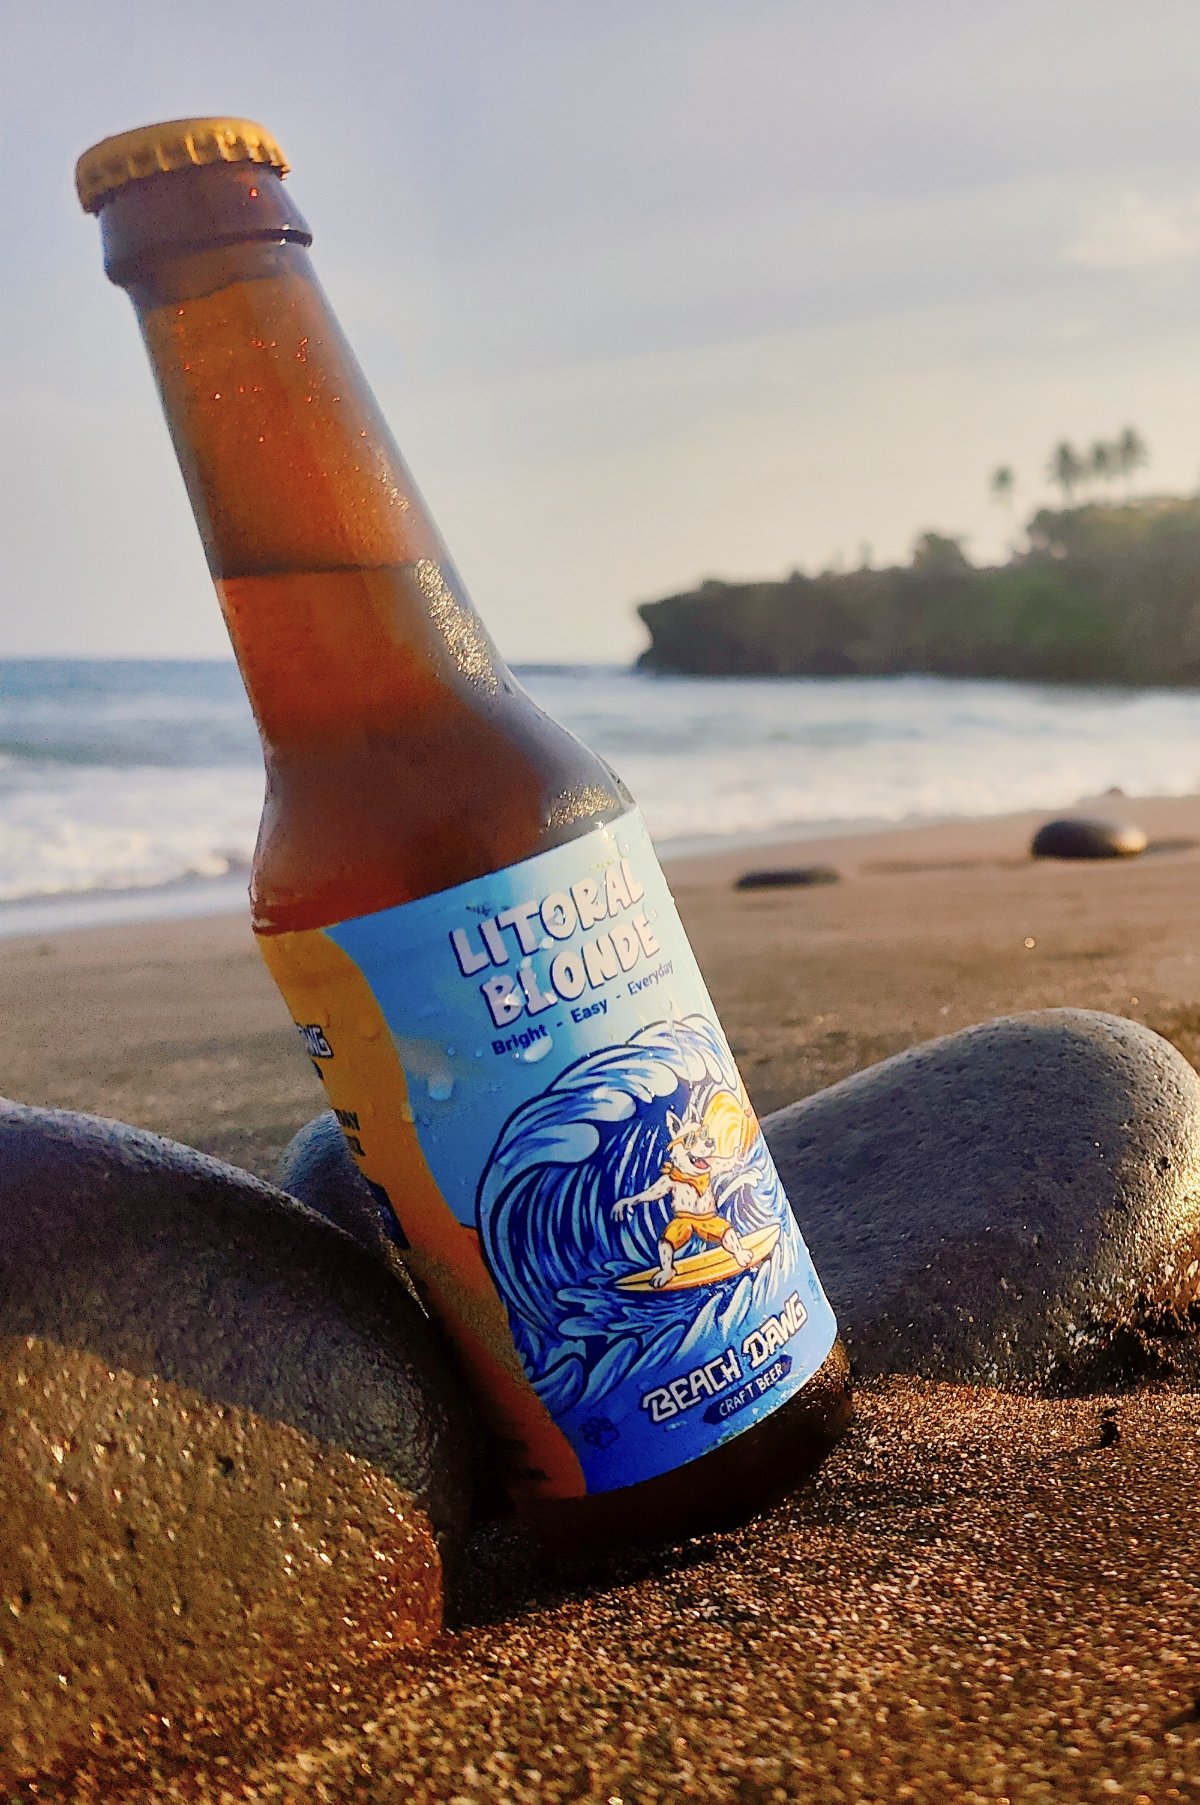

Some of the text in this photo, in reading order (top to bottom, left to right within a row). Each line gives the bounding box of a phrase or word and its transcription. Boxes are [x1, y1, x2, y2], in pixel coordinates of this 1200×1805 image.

[449, 860, 645, 978] LITORAL
[480, 914, 661, 1029] BLONDE
[492, 1023, 549, 1055] Bright
[570, 998, 608, 1024] Easy
[627, 959, 674, 996] Everyday
[642, 1290, 808, 1424] BEACH DAWG
[718, 1362, 784, 1417] CRAFT BEER
